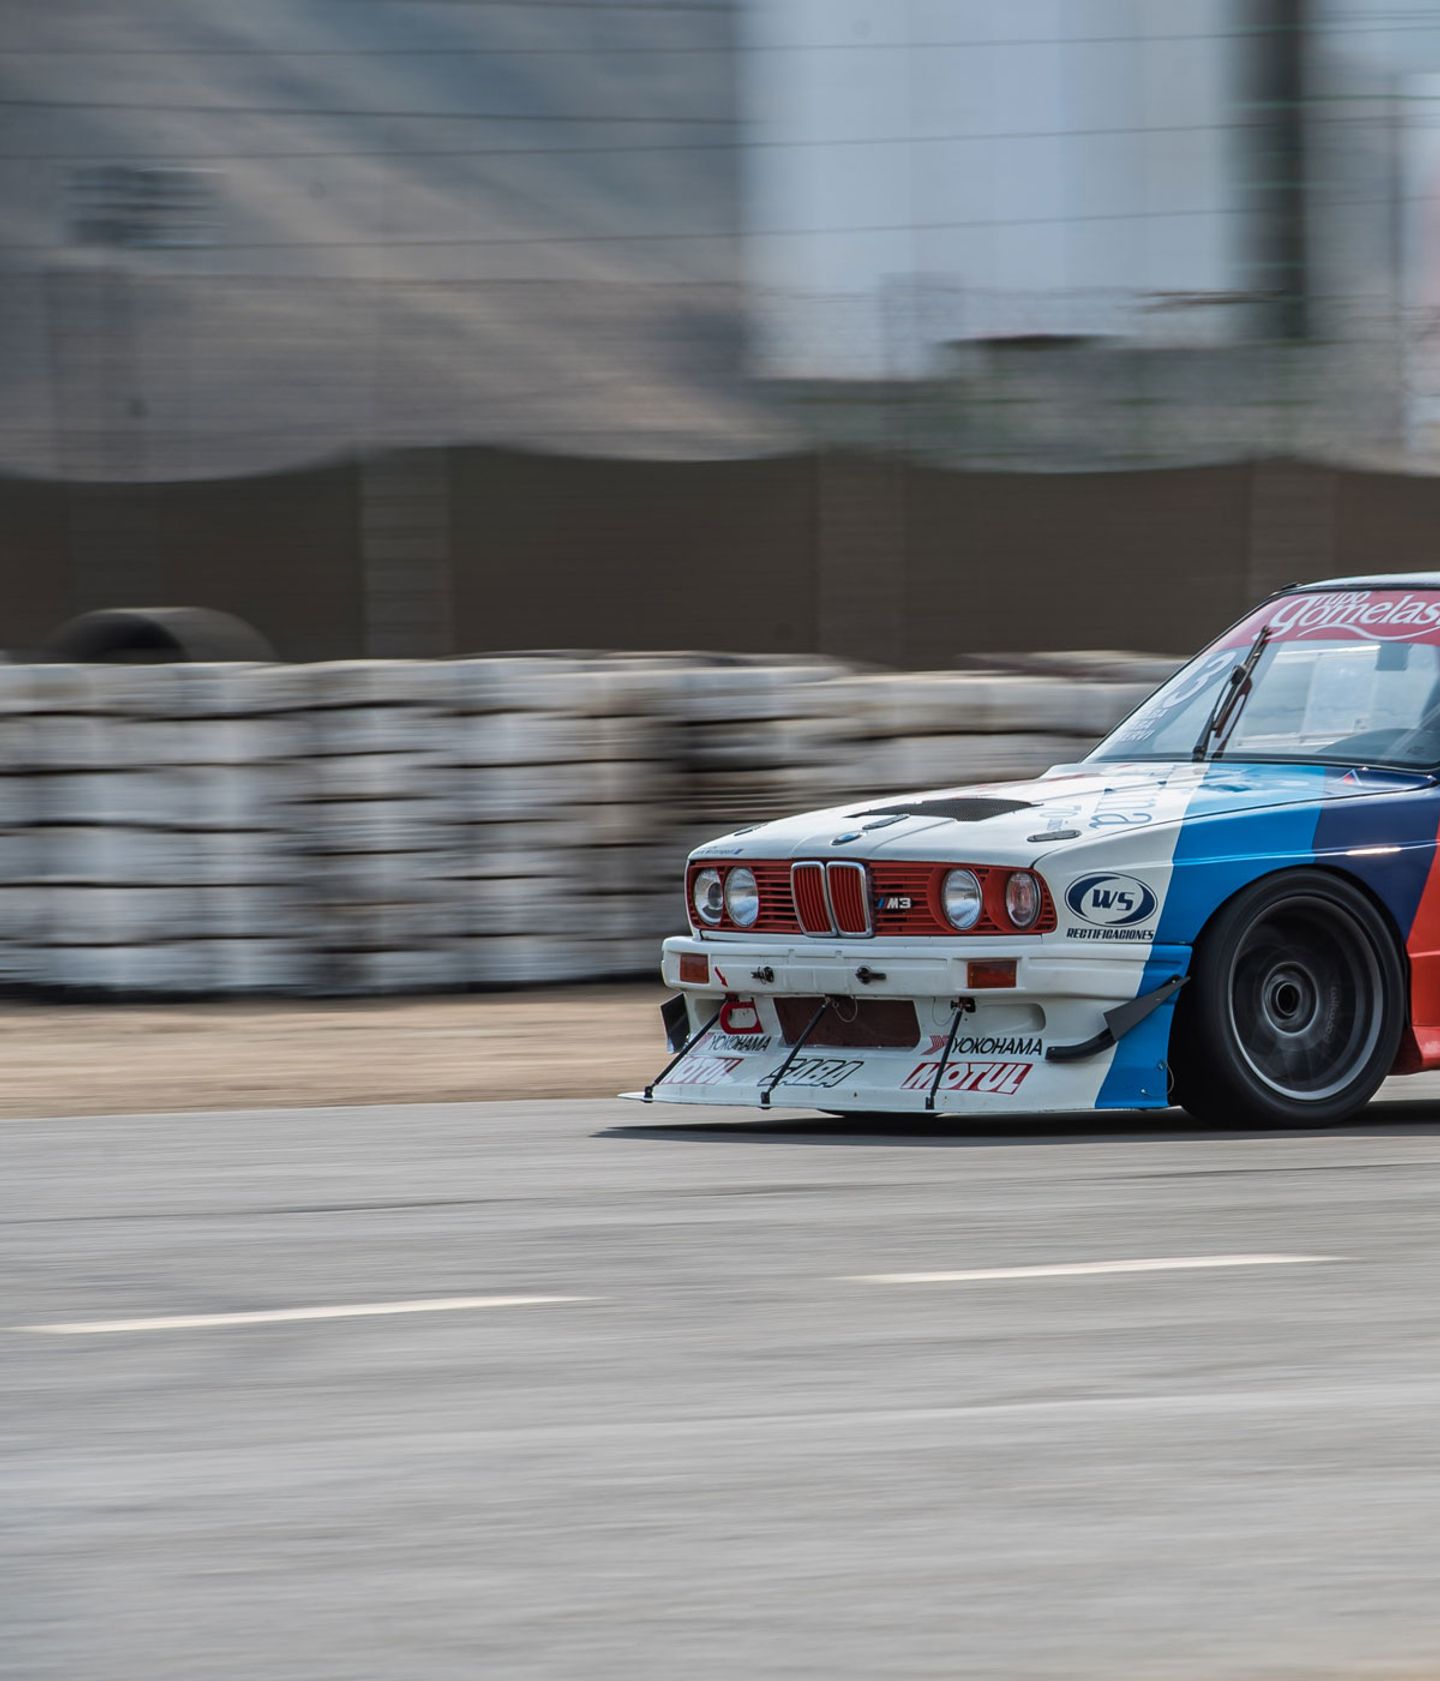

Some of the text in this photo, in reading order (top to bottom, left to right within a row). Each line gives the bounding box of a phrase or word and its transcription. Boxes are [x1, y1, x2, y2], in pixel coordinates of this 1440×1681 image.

[885, 896, 911, 910] M3
[1090, 888, 1135, 911] WS
[1066, 927, 1154, 941] RECTIFICACIONES
[709, 1034, 772, 1052] YOKOHAMA
[952, 1036, 1043, 1057] YOKOHAMA
[902, 1063, 1032, 1094] MOTUL
